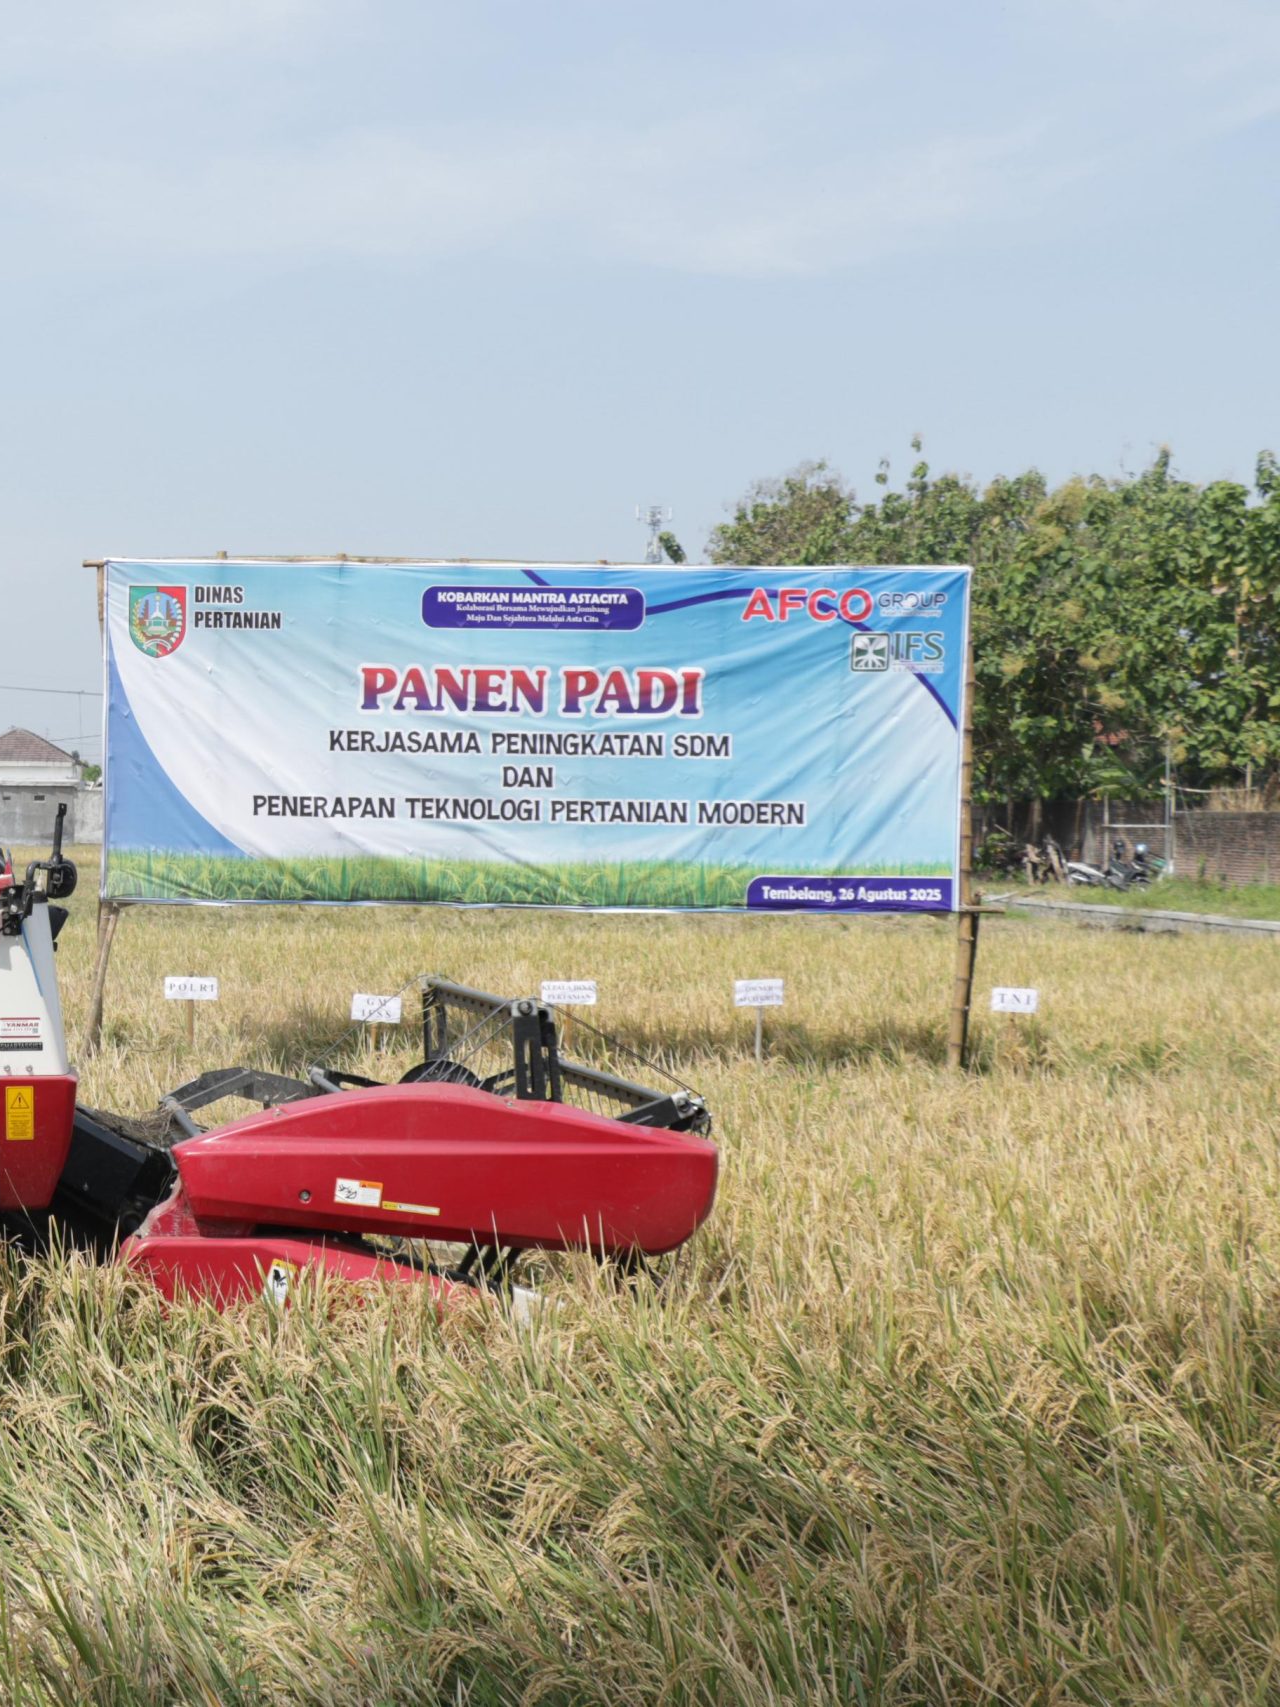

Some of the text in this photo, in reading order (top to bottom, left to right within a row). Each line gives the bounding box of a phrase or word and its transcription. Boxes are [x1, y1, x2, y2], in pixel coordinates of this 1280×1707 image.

[194, 586, 243, 603] DINAS
[437, 591, 628, 604] KOBARKAN MANTRA ASTACITA
[456, 603, 610, 614] Kolaborasi Bersama Mewujudkan Jombang
[741, 588, 946, 621] AFCO GROUP
[194, 611, 281, 629] PERTANIAN
[466, 614, 599, 624] Maju Dan Sejahtera Melalui Asta Cita
[893, 632, 944, 660] IFS
[361, 667, 703, 714] PANEN PADI
[329, 730, 729, 757] KERJASAMA PENINGKATAN SDM
[502, 766, 553, 788] DAN
[252, 795, 804, 824] PENERAPAN TEKNOLOGI PERTANIAN MODERN
[762, 886, 942, 902] Tembelang, 26 Agustus 2025
[169, 983, 214, 992] POLRI
[998, 993, 1031, 1005] TNI
